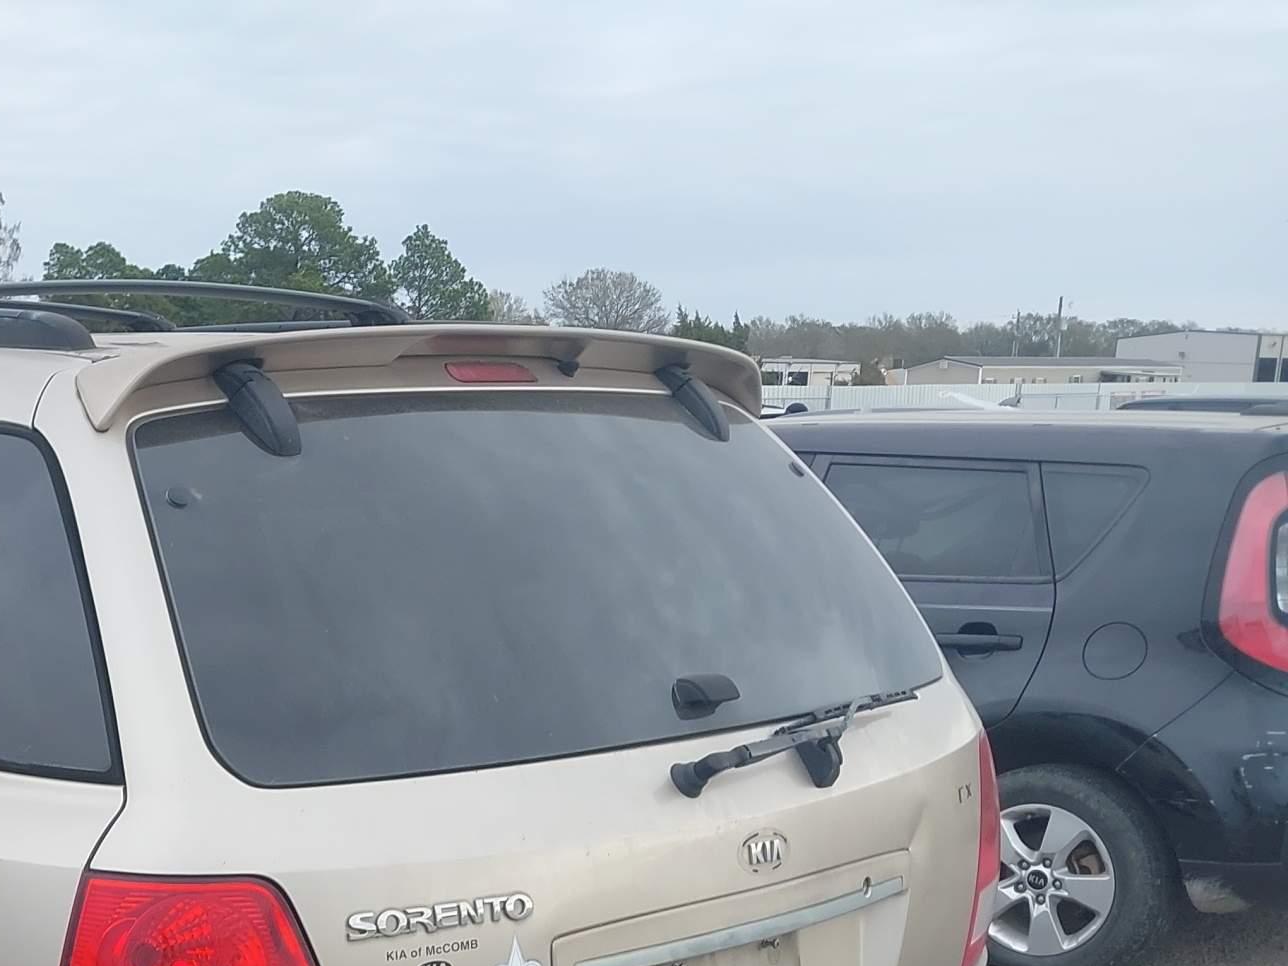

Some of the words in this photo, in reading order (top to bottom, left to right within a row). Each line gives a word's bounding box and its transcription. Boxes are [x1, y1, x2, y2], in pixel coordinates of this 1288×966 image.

[747, 839, 782, 865] KIA
[346, 891, 534, 941] SORENTO
[386, 950, 407, 961] KIA
[411, 947, 421, 958] of
[426, 939, 478, 956] McCOMB
